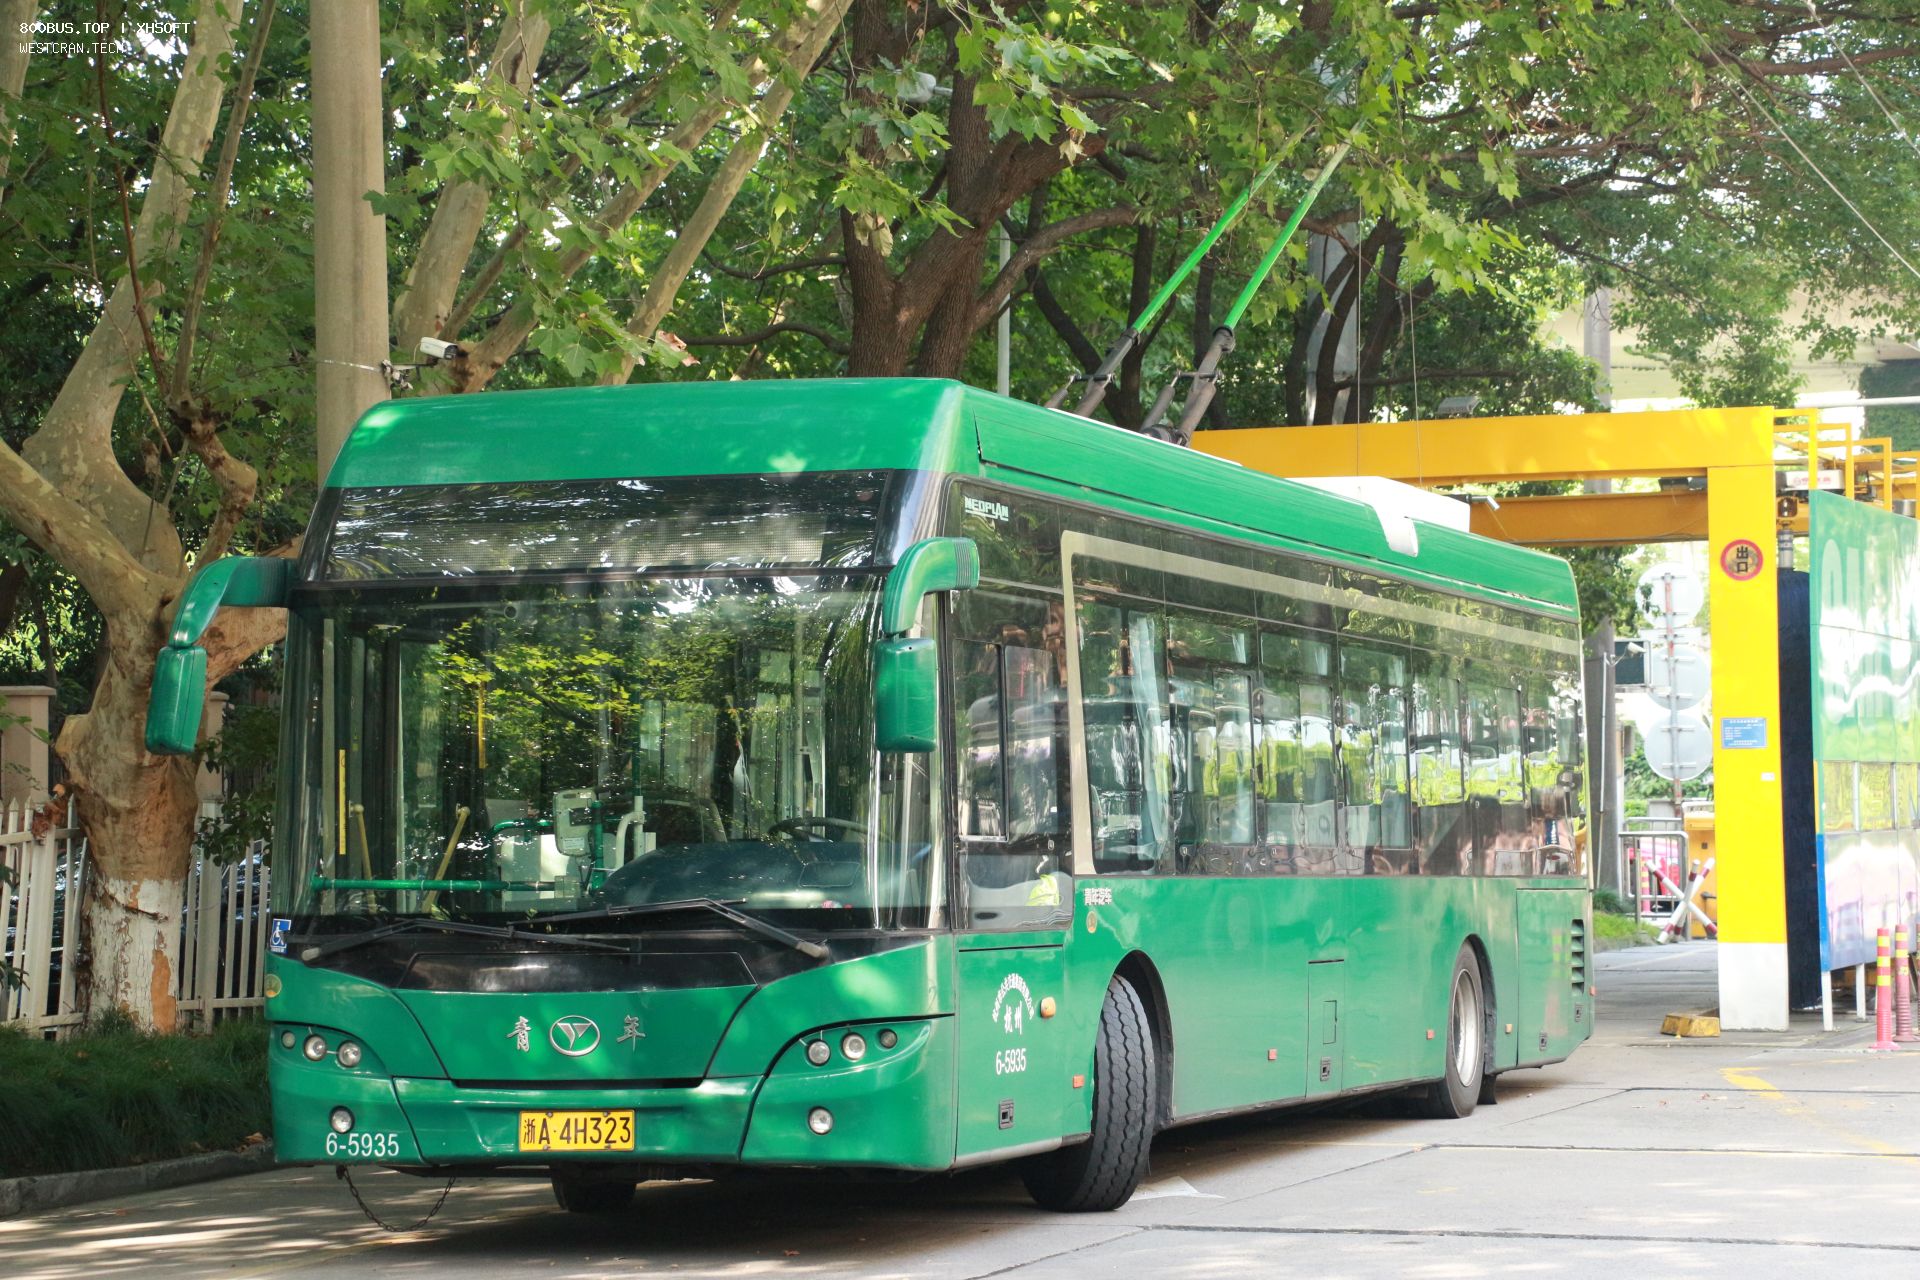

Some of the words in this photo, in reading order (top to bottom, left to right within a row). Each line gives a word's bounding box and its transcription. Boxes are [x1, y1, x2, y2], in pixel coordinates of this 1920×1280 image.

[1735, 545, 1749, 573] 出口
[995, 1047, 1027, 1076] 6-5935
[325, 1132, 400, 1157] 6-5935
